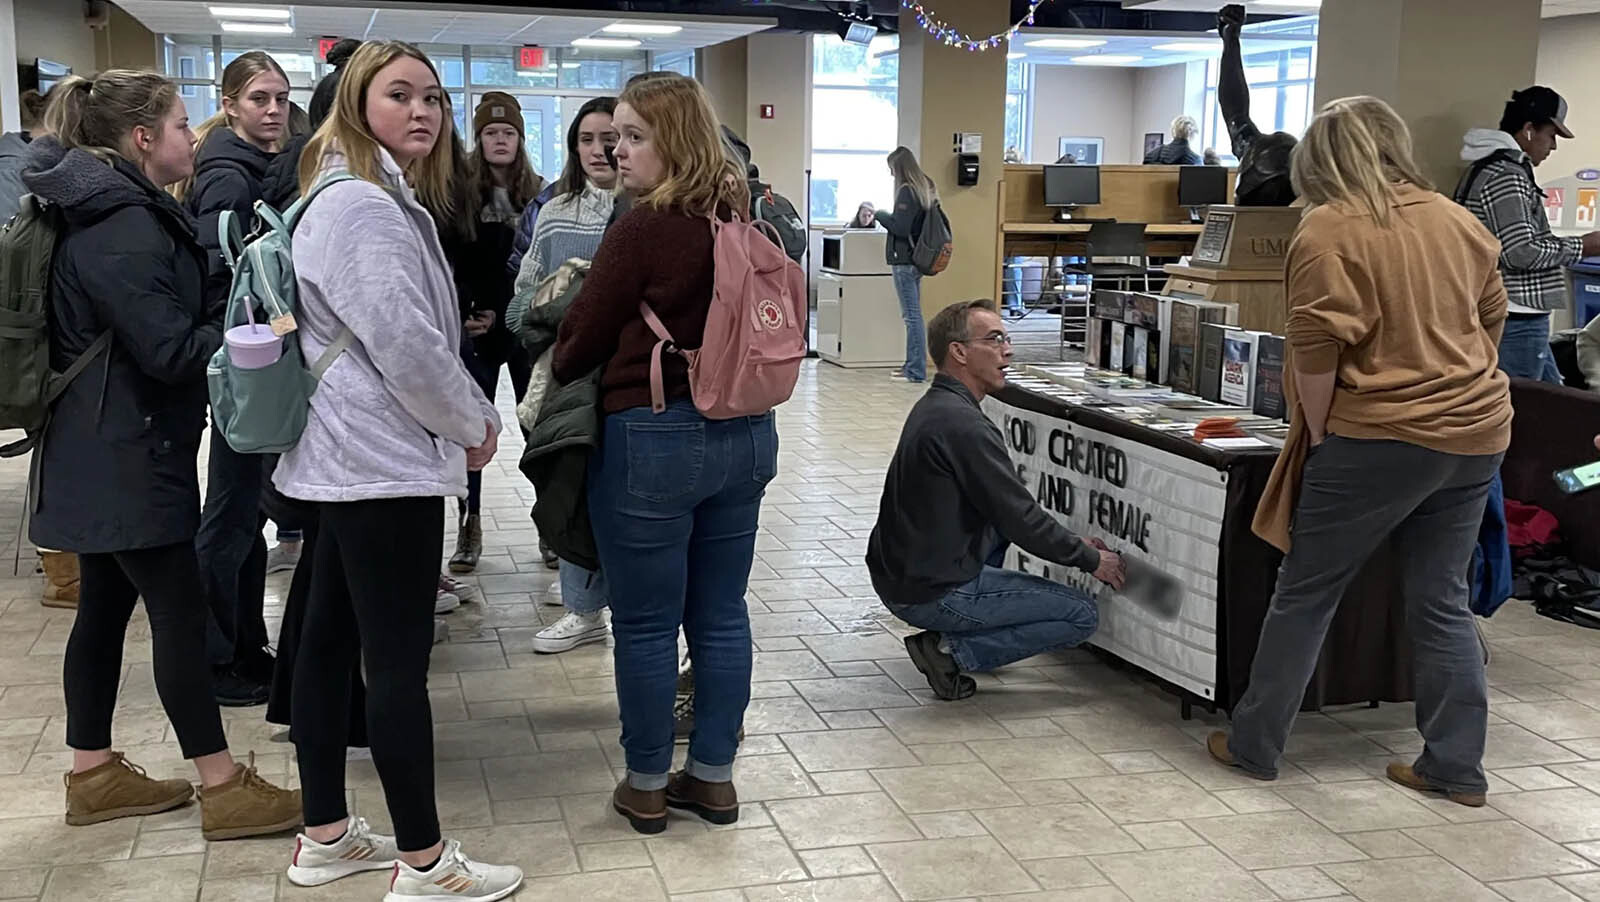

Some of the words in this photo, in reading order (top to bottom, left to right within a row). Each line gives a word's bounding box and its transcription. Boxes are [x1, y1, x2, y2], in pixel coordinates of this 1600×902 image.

[521, 48, 544, 67] EXIT
[1048, 428, 1127, 489] CREATED
[1038, 472, 1074, 516] AND
[1089, 489, 1151, 553] FEMALE
